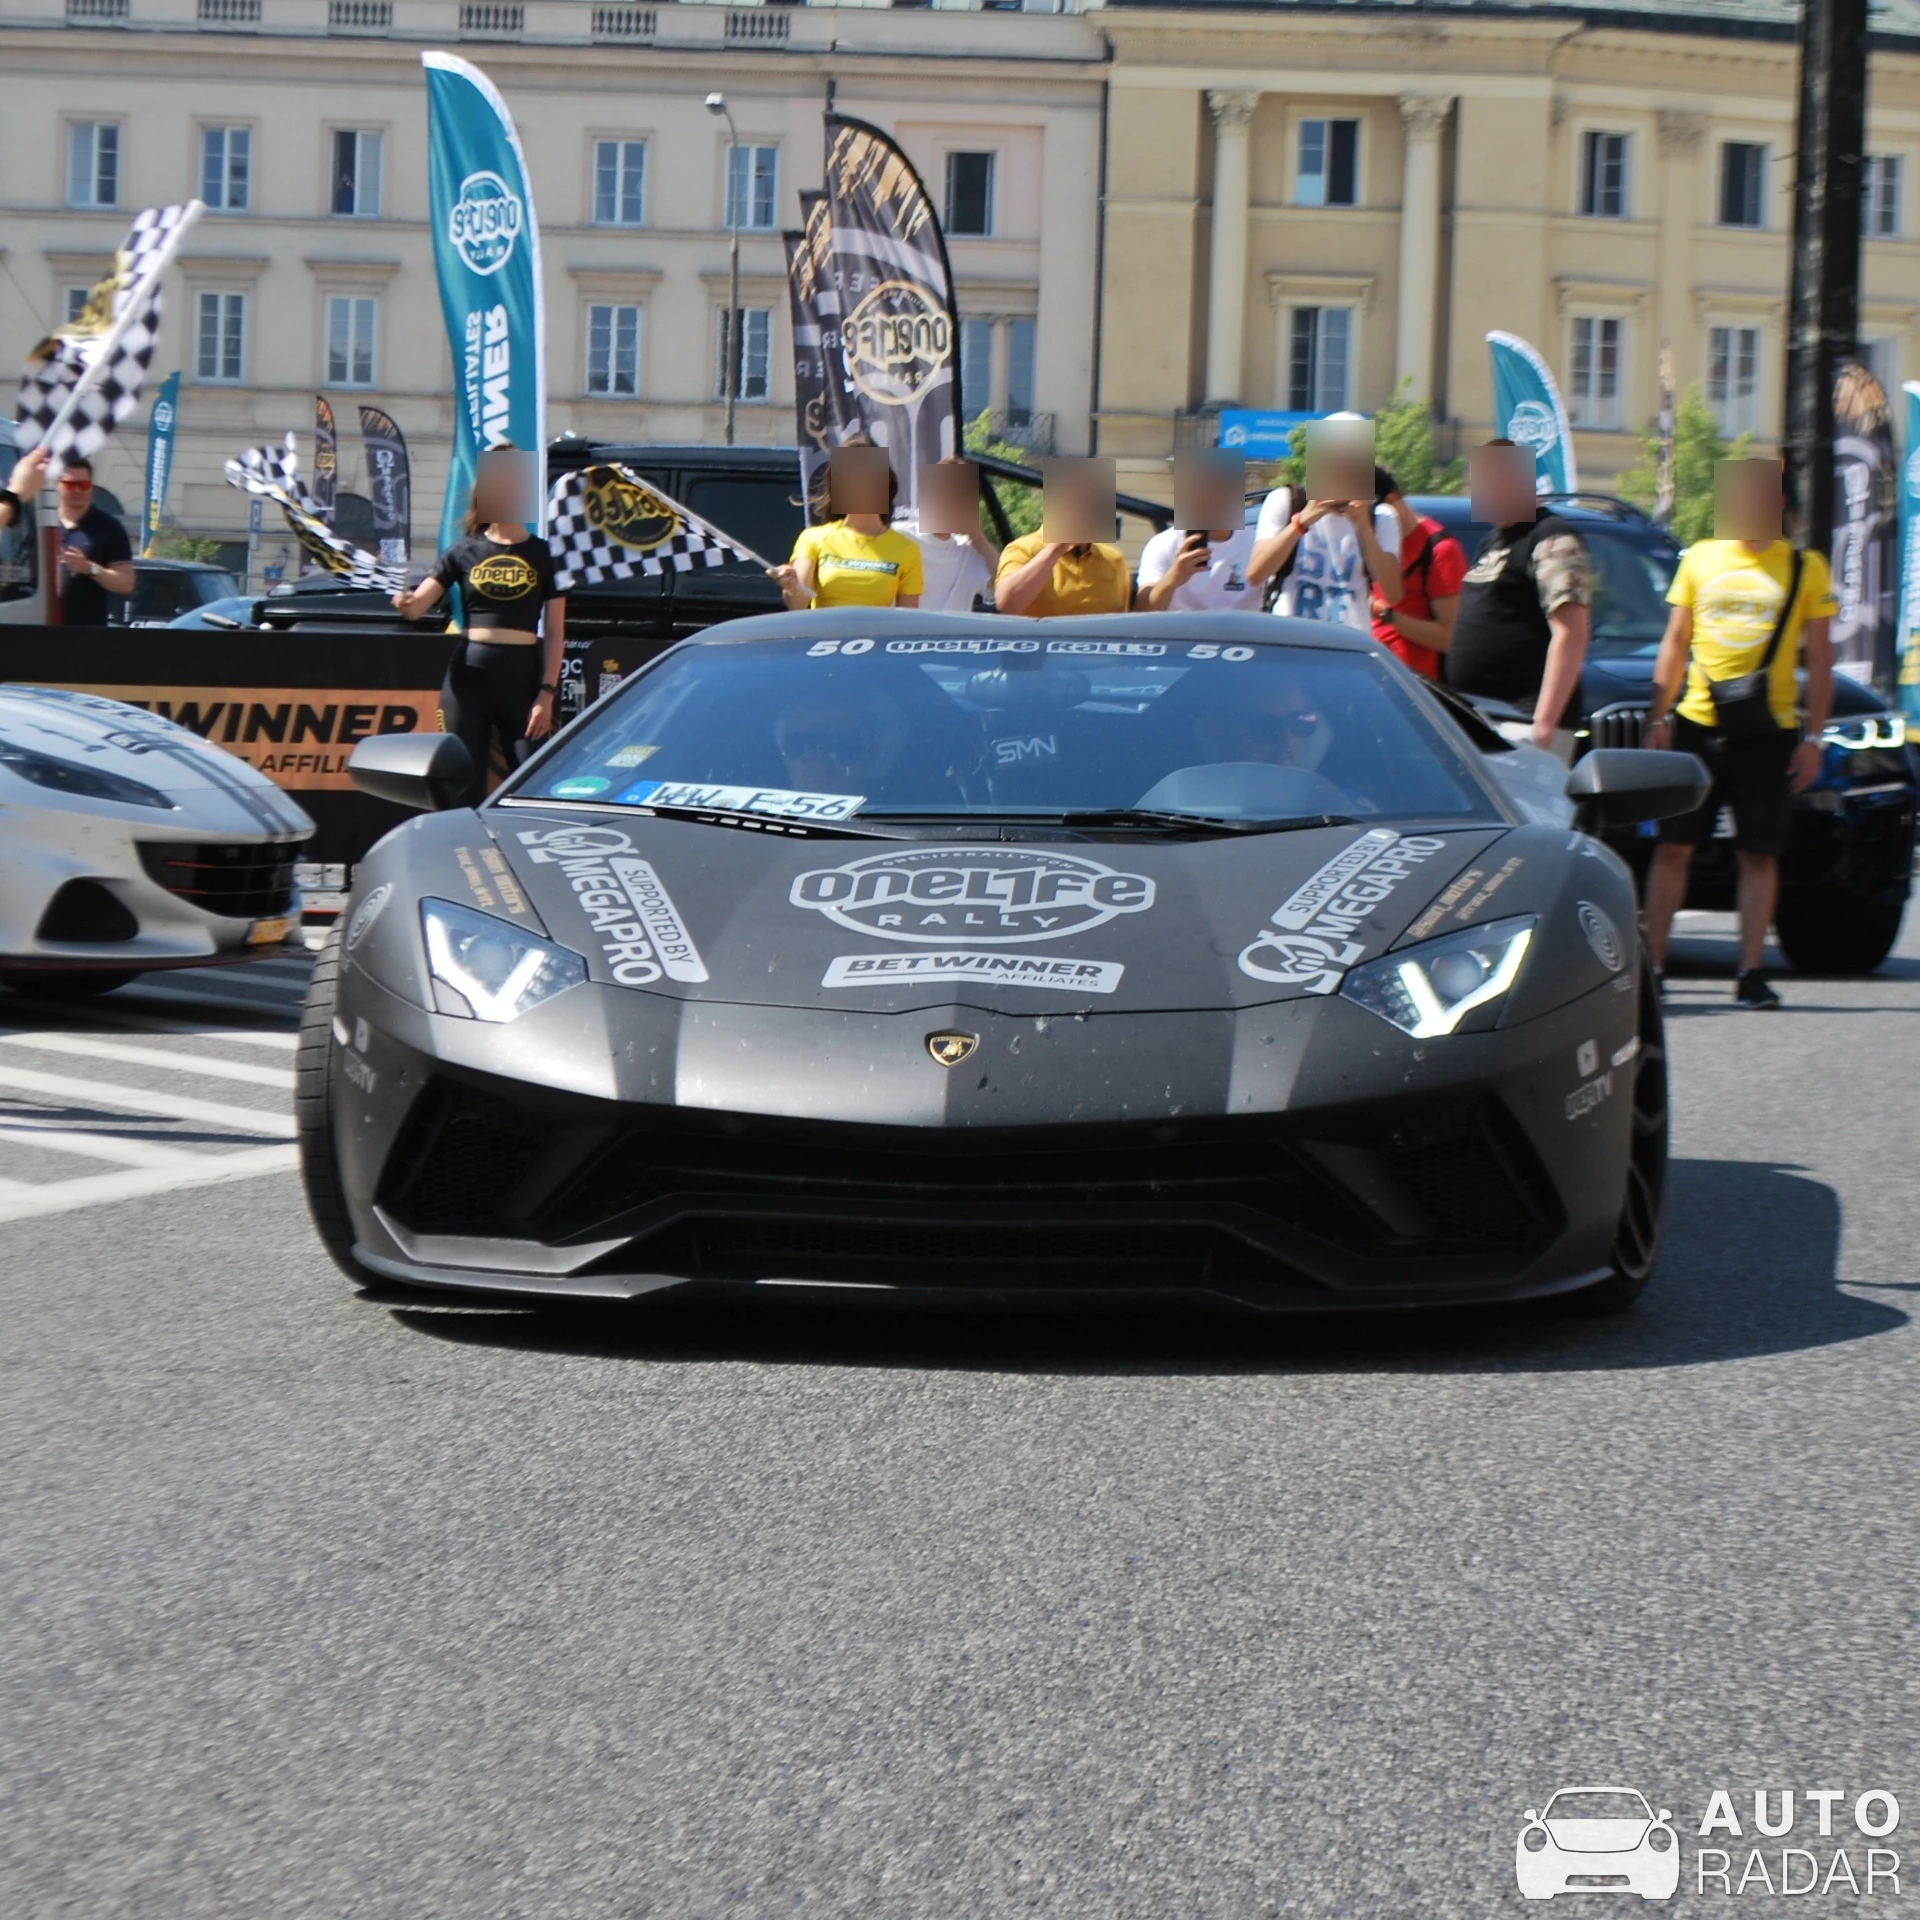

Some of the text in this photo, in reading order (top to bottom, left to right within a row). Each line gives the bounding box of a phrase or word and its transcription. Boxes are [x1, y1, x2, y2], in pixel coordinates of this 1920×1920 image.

[806, 638, 875, 657] 50
[1186, 643, 1256, 662] 50
[995, 735, 1057, 764] SMN
[258, 754, 350, 774] AFFILI
[783, 796, 848, 817] 56
[1286, 851, 1370, 914] SUPPORTED
[1355, 838, 1386, 854] BY
[1304, 836, 1447, 940] MEGAPRO
[558, 857, 663, 985] MEGAPRO
[624, 869, 695, 964] SUPPORTED BY
[877, 912, 1061, 929] RALLY
[997, 973, 1099, 987] AFFILIATES
